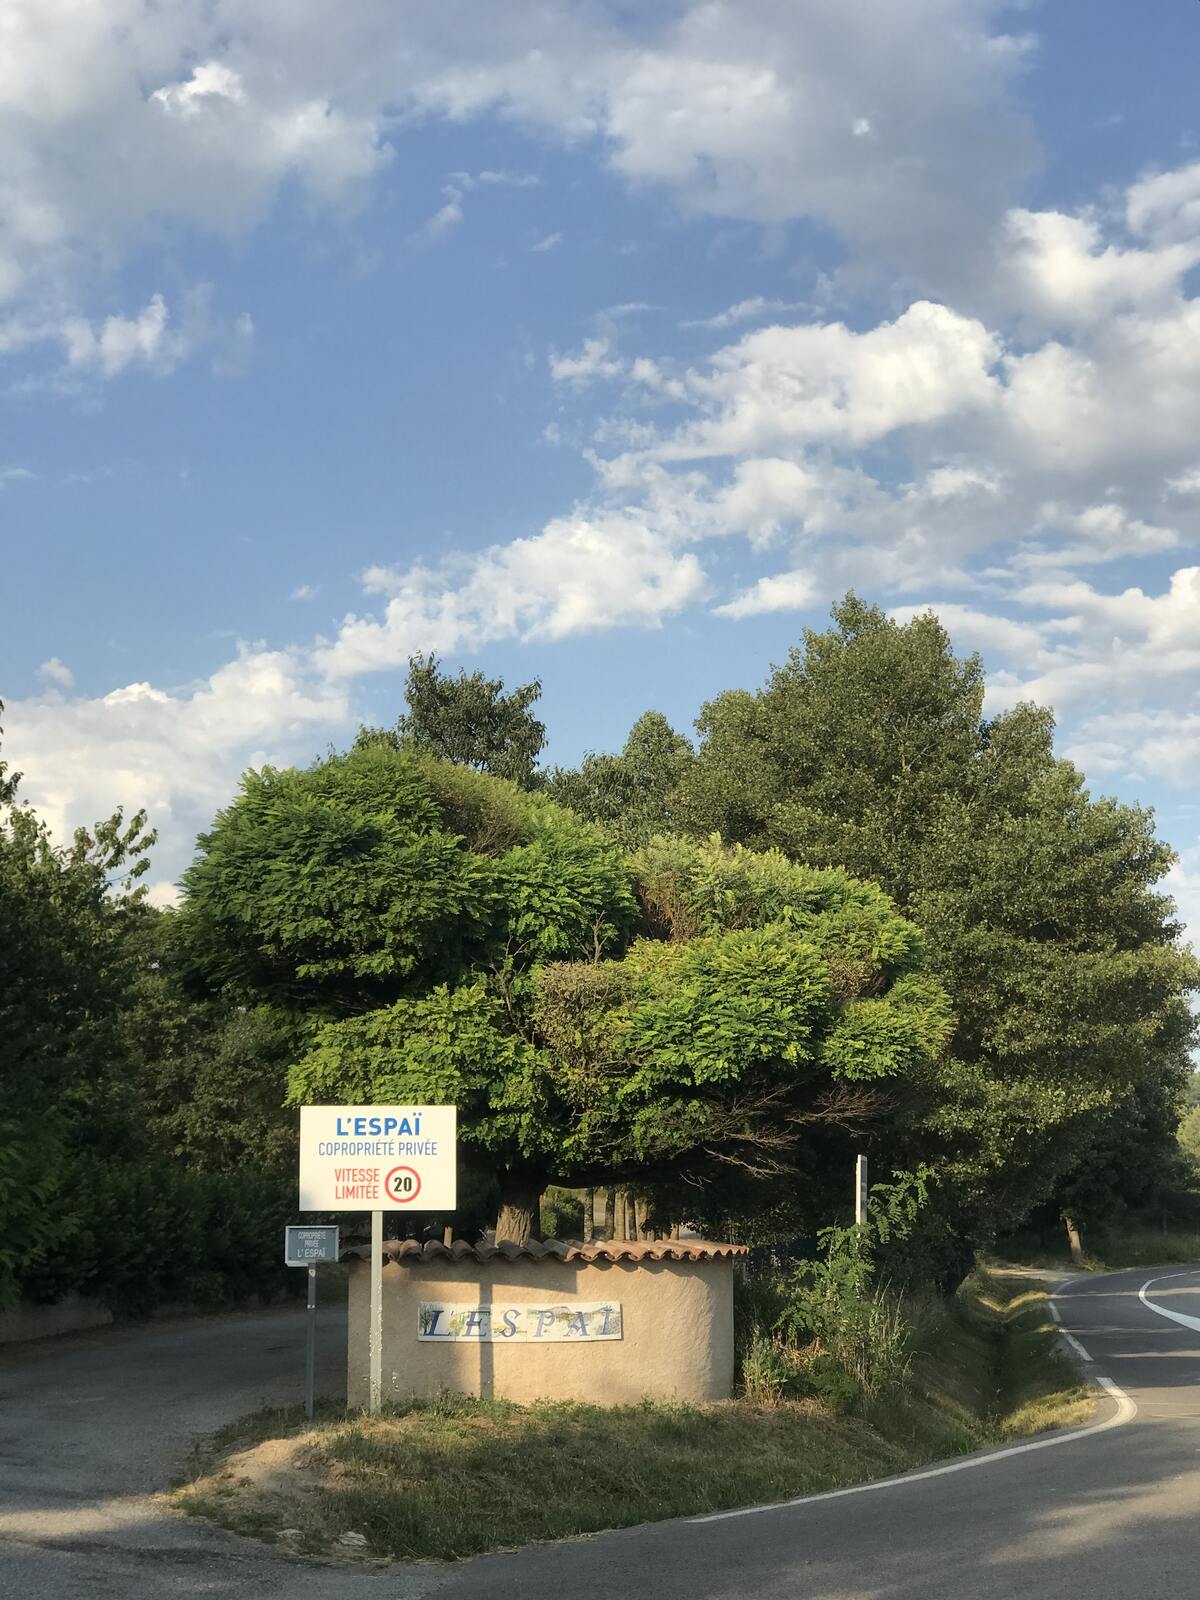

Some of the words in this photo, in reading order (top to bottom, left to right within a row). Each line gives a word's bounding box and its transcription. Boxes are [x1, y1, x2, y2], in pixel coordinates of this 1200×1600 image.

[336, 1112, 422, 1136] L'ESPAÏ
[318, 1139, 394, 1156] COPROPRIÉTÉ
[398, 1139, 438, 1156] PRIVÉE
[334, 1168, 380, 1182] VITESSE
[335, 1183, 379, 1200] LIMITÉE
[393, 1176, 412, 1193] 20
